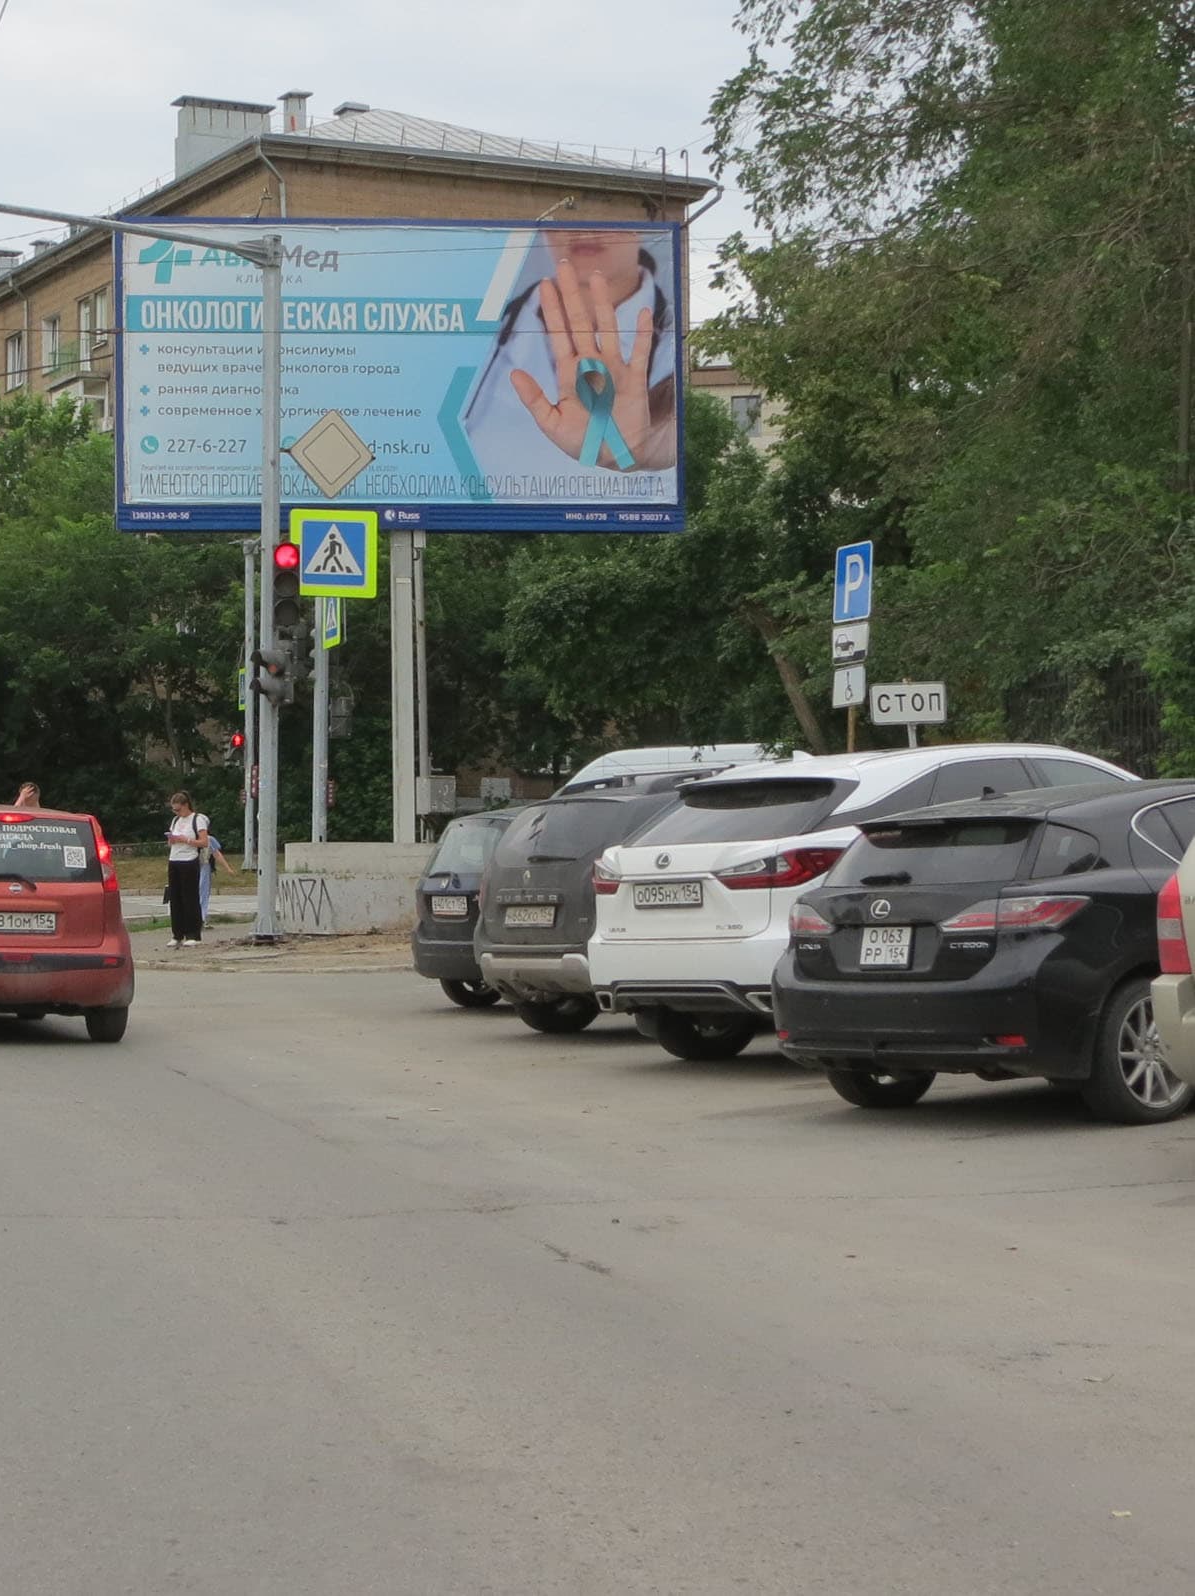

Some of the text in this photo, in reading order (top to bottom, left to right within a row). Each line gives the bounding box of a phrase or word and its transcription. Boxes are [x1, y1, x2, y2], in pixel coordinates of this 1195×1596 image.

[141, 300, 465, 333] ОНКОЛОГИЕСКАЯ СЛУЖБА
[157, 345, 253, 357] консультации
[278, 346, 356, 358] онсилиумы
[157, 364, 219, 375] ведущих
[353, 366, 400, 376] города
[158, 386, 208, 396] ранняя
[157, 407, 252, 418] современное
[364, 408, 422, 417] лечение
[167, 439, 247, 453] 227-6-227
[367, 440, 431, 454] d-nsk.ru
[140, 473, 209, 496] ИМЕЮТСЯ
[365, 474, 456, 497] НЕОБХОДИМА
[460, 475, 566, 497] КОНСУЛЬТАЦИЯ
[568, 475, 665, 498] СПЕЦИАЛИСТА
[398, 511, 421, 520] Russ
[843, 553, 865, 614] P
[877, 692, 942, 713] СТОП
[2, 824, 77, 835] ПОДРОСТКОВАЯ
